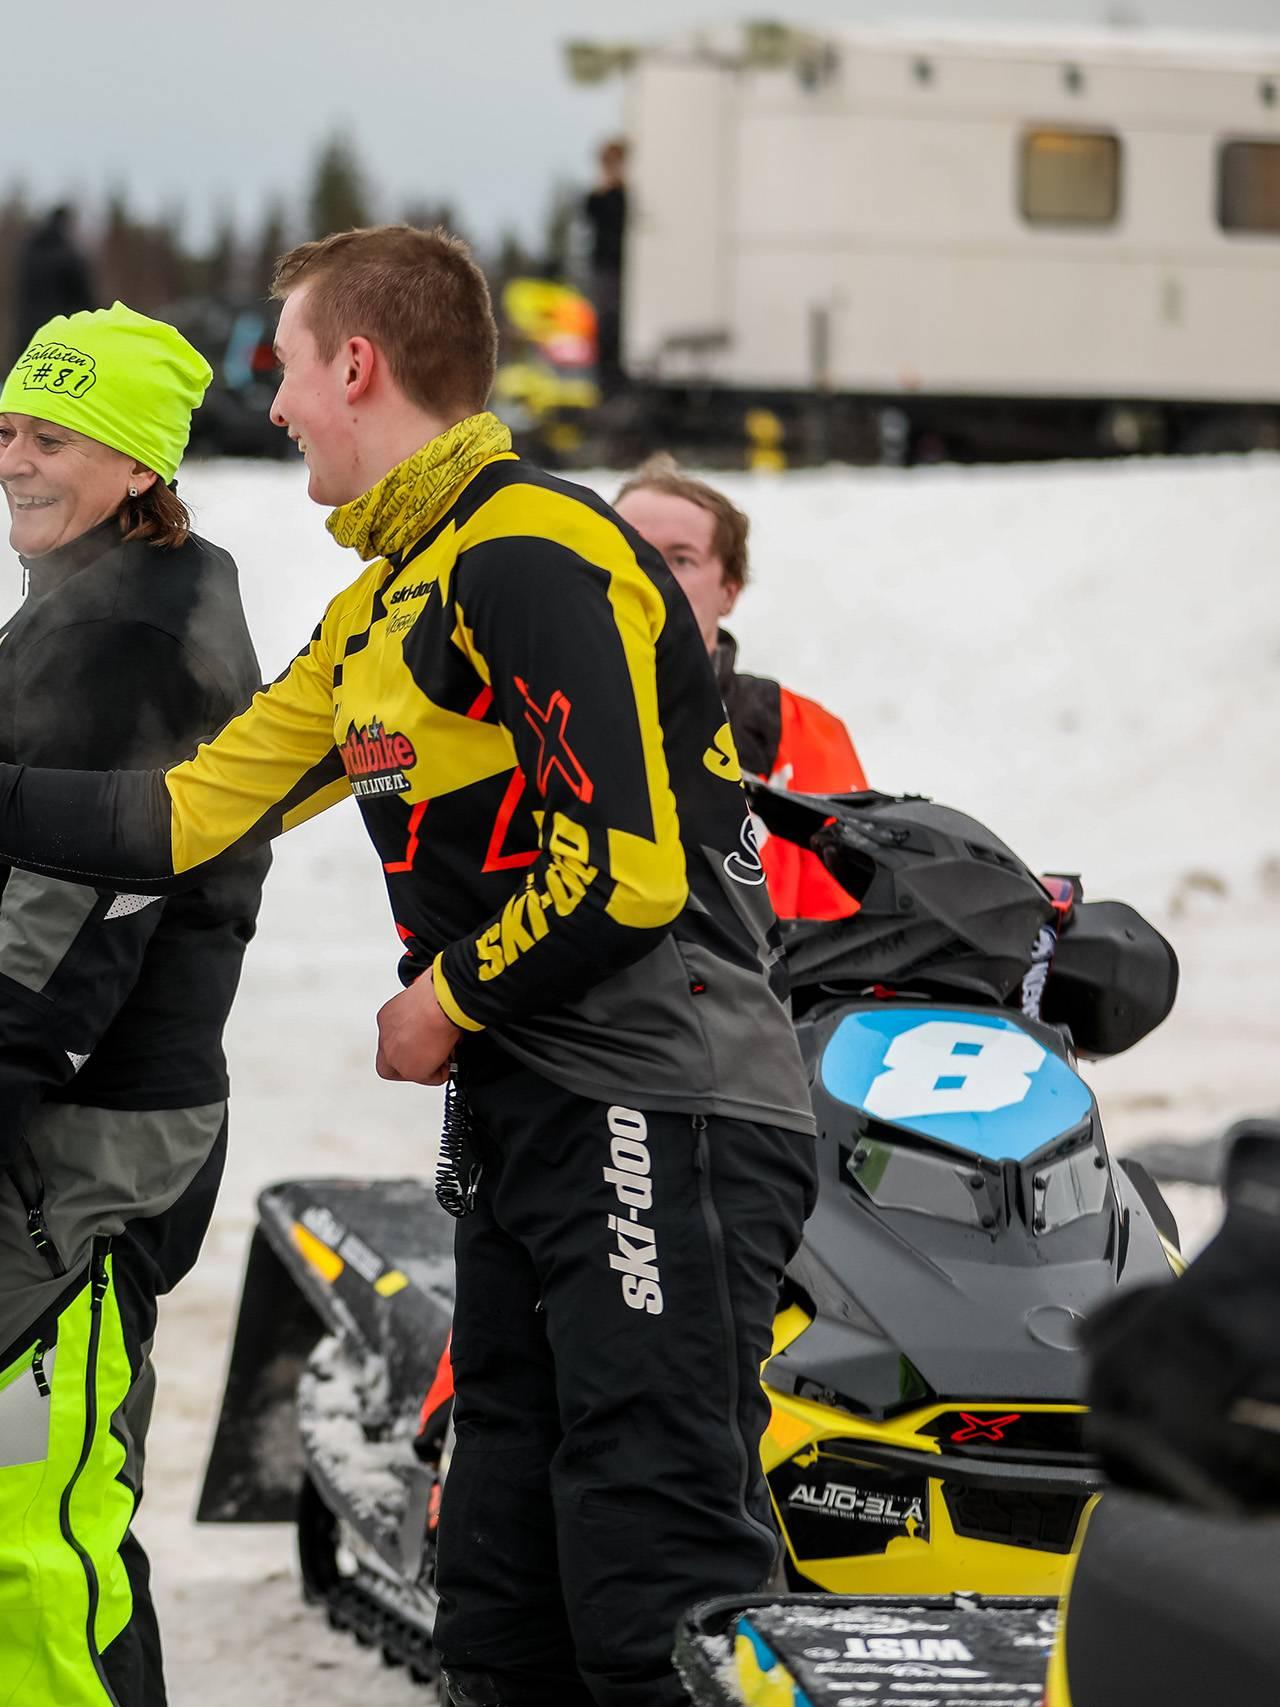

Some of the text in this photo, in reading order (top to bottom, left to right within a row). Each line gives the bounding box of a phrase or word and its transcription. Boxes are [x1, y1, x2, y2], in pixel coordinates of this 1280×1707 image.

[863, 1020, 1047, 1120] 8
[602, 1104, 664, 1316] ski-doo
[843, 1636, 974, 1662] WIST
